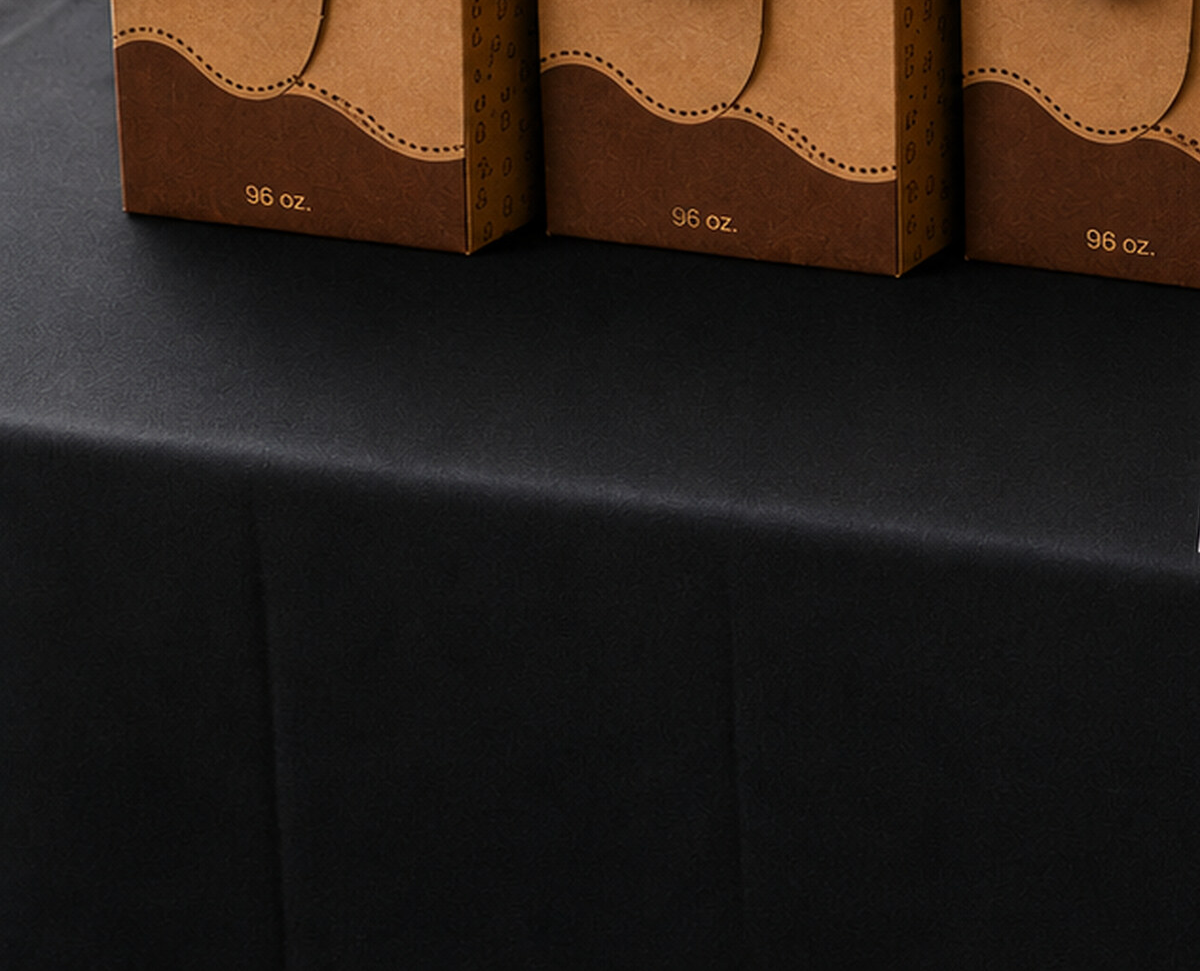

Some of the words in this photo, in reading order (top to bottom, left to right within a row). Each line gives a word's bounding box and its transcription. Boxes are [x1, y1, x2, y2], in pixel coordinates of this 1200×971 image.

[244, 184, 274, 206] 96
[279, 193, 312, 212] oz.
[671, 206, 700, 229] 96
[705, 214, 738, 233] oz.
[1086, 229, 1117, 252] 96
[1122, 238, 1156, 257] oz.
